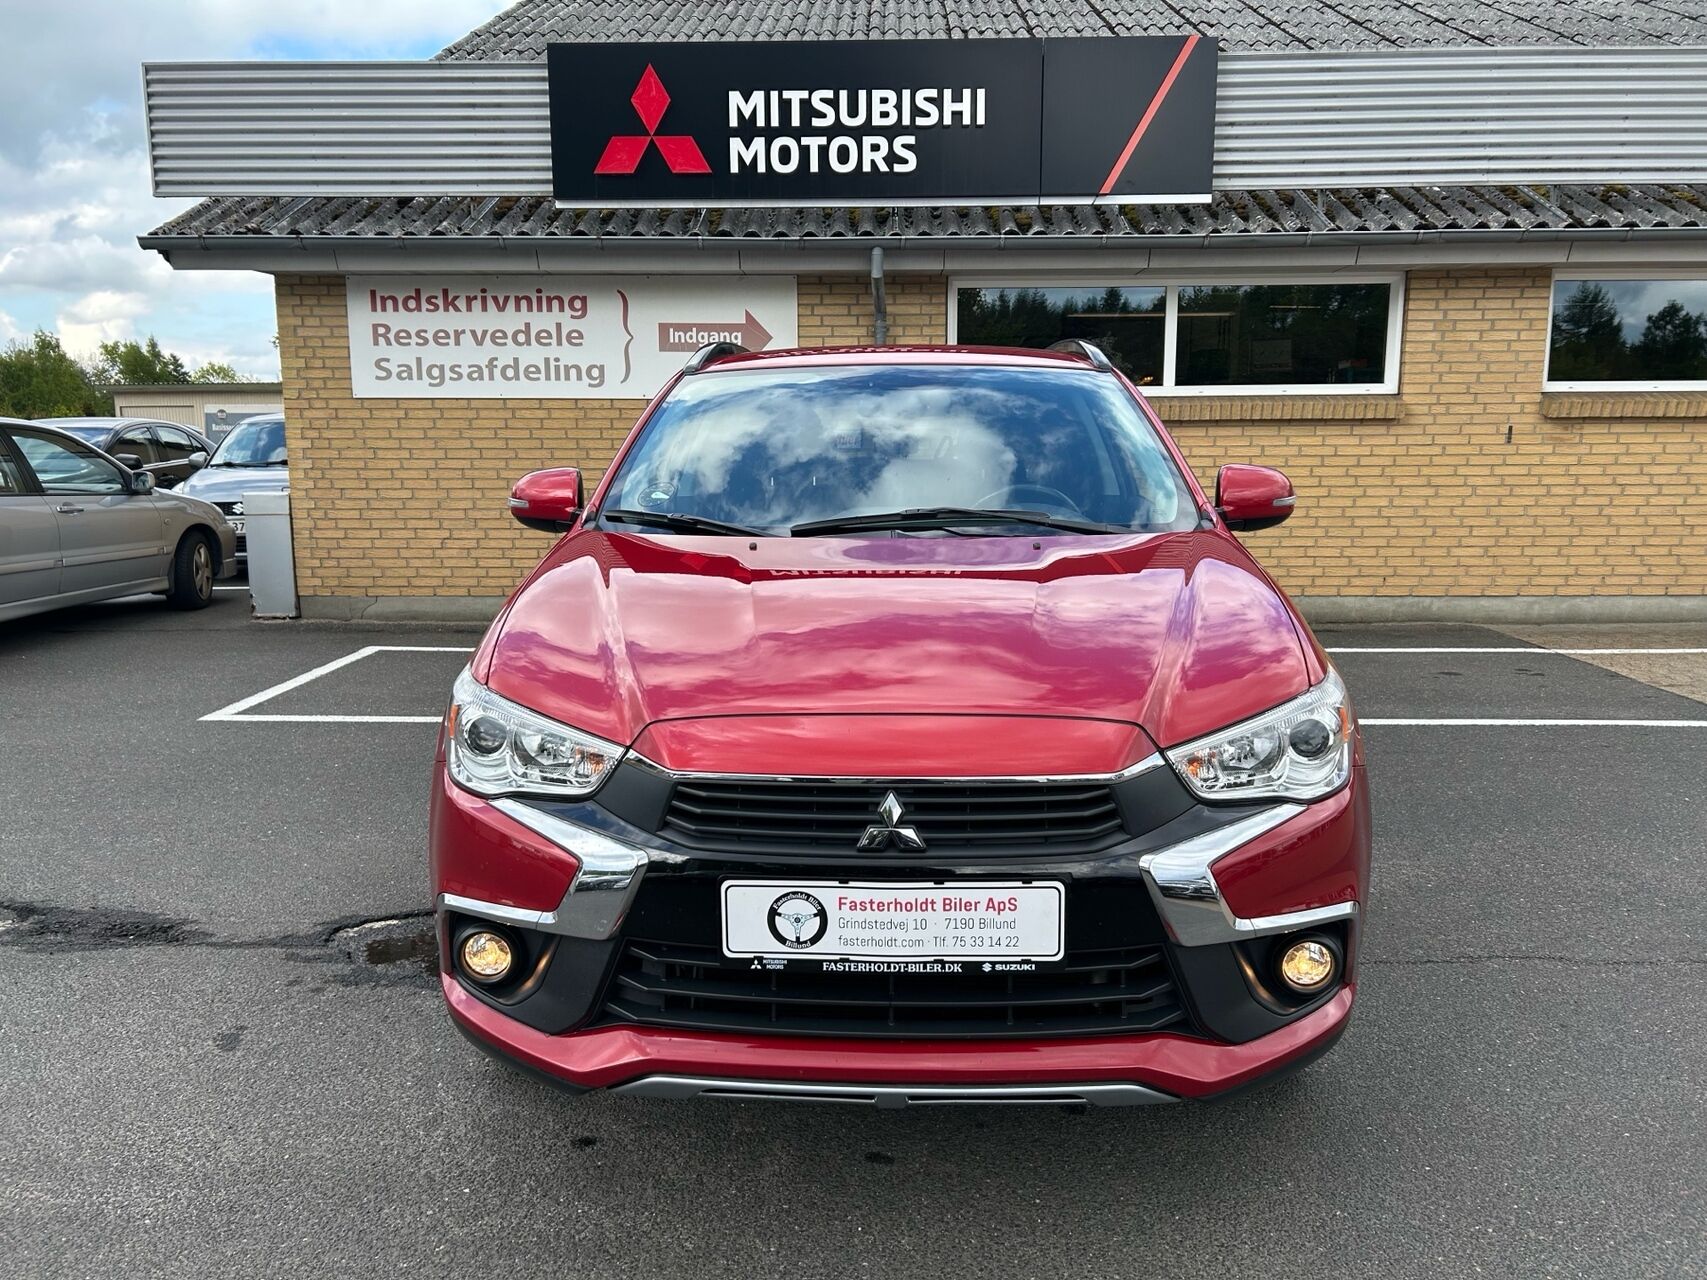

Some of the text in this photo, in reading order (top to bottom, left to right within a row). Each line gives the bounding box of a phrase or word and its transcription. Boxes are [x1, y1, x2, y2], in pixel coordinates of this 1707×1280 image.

[728, 88, 987, 129] MITSUBISHI
[729, 135, 918, 175] MOTORS
[369, 288, 588, 320] Indskrivning
[371, 322, 585, 347] Reservedele
[669, 327, 742, 347] Indgang
[374, 356, 606, 388] Salgsafdeling
[838, 896, 1018, 916] Fasterholdt Biler ApS
[838, 916, 1016, 933] Grindstedvej 10 7190 Billund
[838, 934, 1020, 948] fasterholdt.com Tlf. 75 33 14 22
[822, 961, 963, 973] FASTERHOLDT-BILER.DK
[994, 963, 1036, 971] SUZUKI
